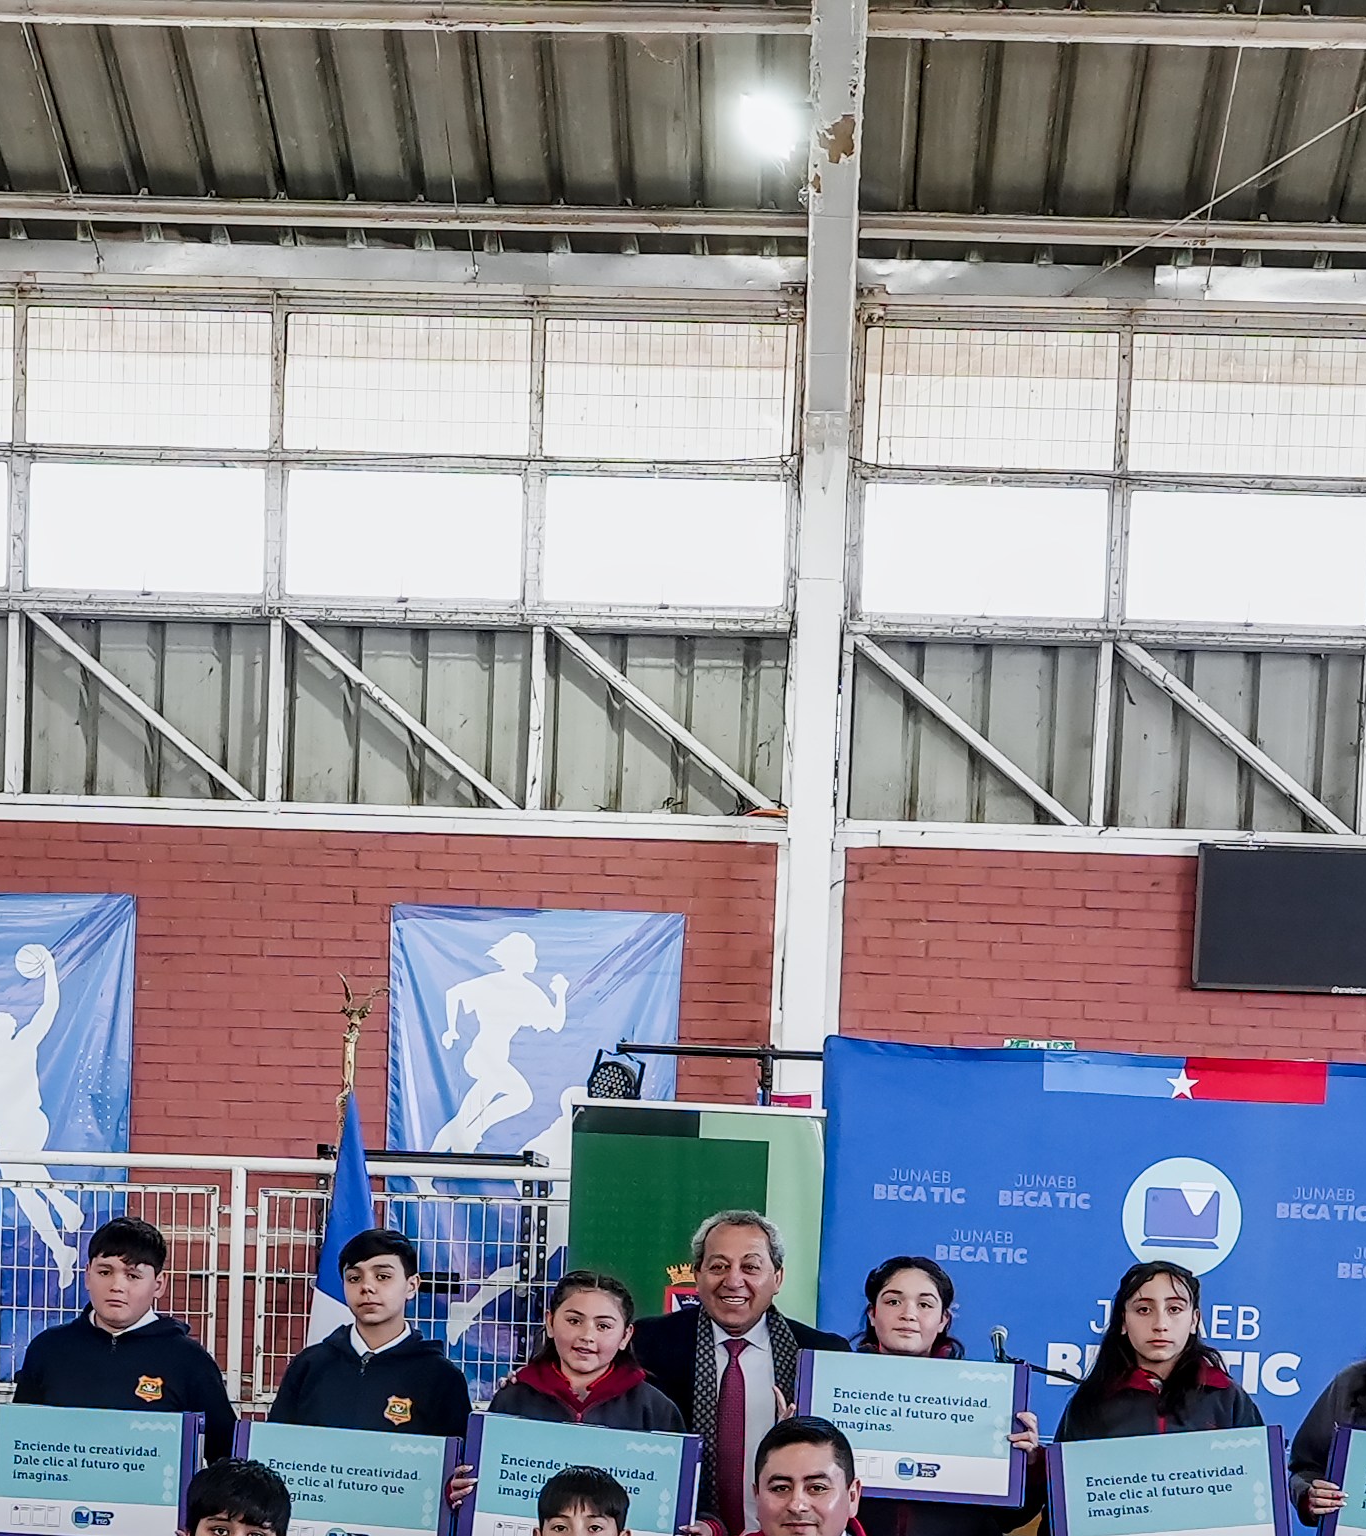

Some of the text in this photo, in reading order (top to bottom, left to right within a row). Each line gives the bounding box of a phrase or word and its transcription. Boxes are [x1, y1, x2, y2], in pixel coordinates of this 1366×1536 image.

[889, 1168, 951, 1184] JUNAEB
[1014, 1174, 1077, 1189] JUNAEB
[874, 1184, 966, 1204] BECA TIC
[999, 1190, 1091, 1209] BECA TIC
[1293, 1187, 1356, 1202] JUNAEB
[1276, 1203, 1331, 1220] BECA
[951, 1229, 1014, 1244] JUNAEB
[935, 1245, 1028, 1264] BECA TIC
